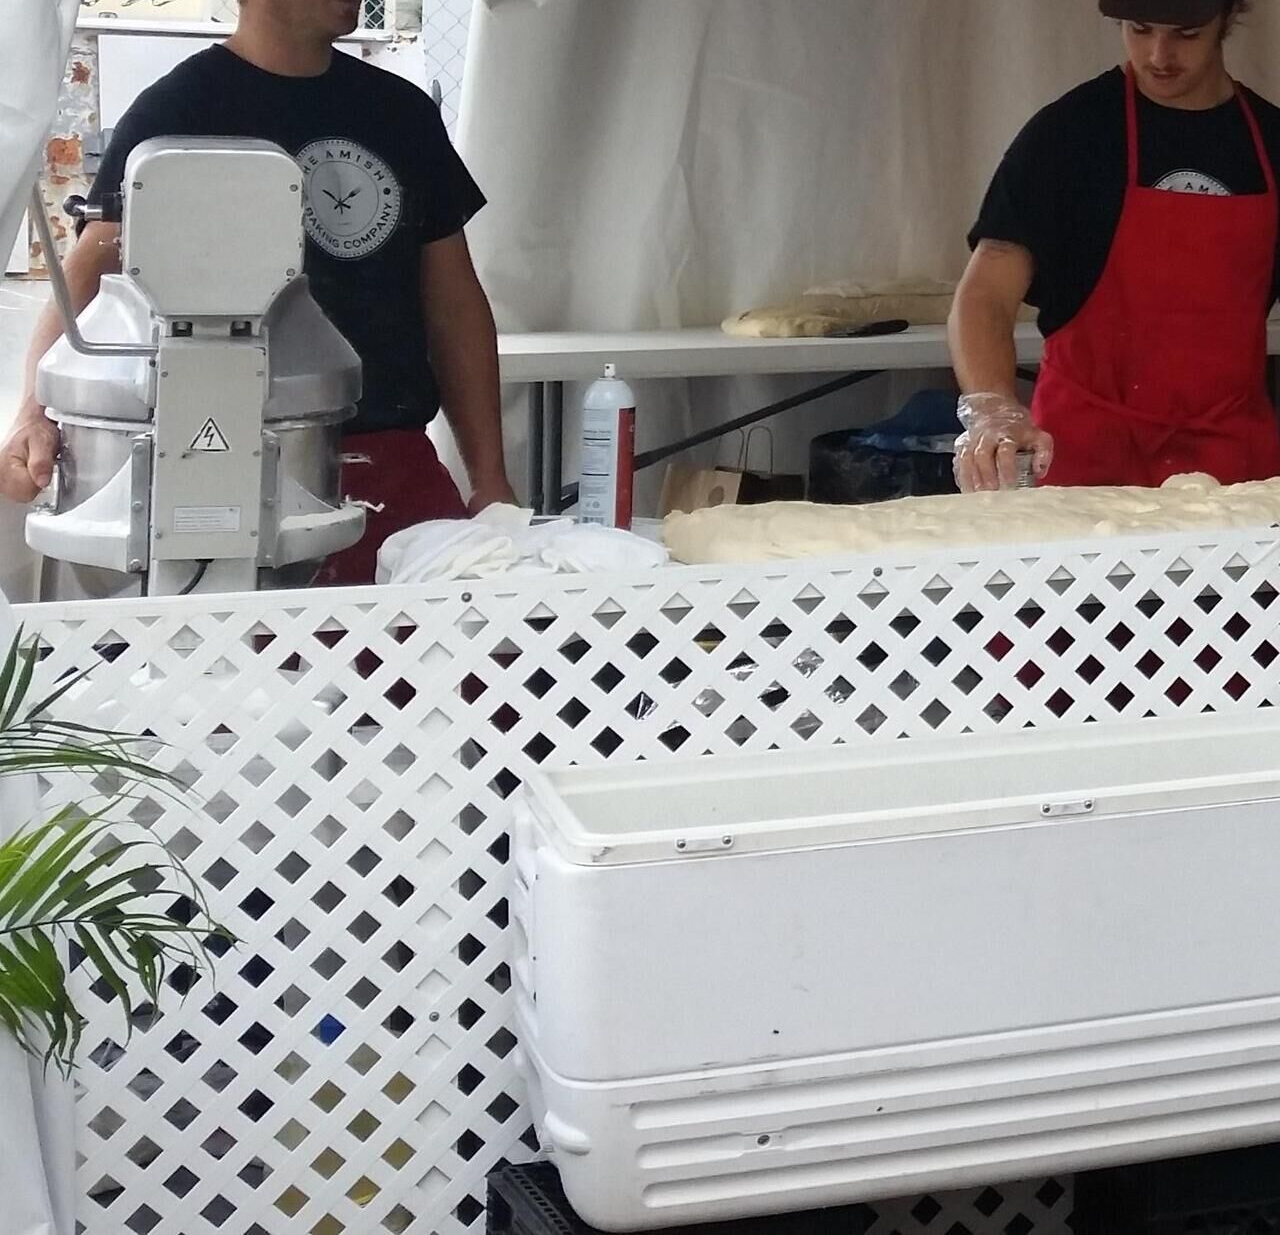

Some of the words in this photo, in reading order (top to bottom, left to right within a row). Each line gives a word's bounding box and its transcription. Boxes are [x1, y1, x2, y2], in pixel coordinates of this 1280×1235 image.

[325, 149, 386, 182] AMISH
[304, 206, 341, 249] BAKING
[342, 201, 393, 250] COMPANY
